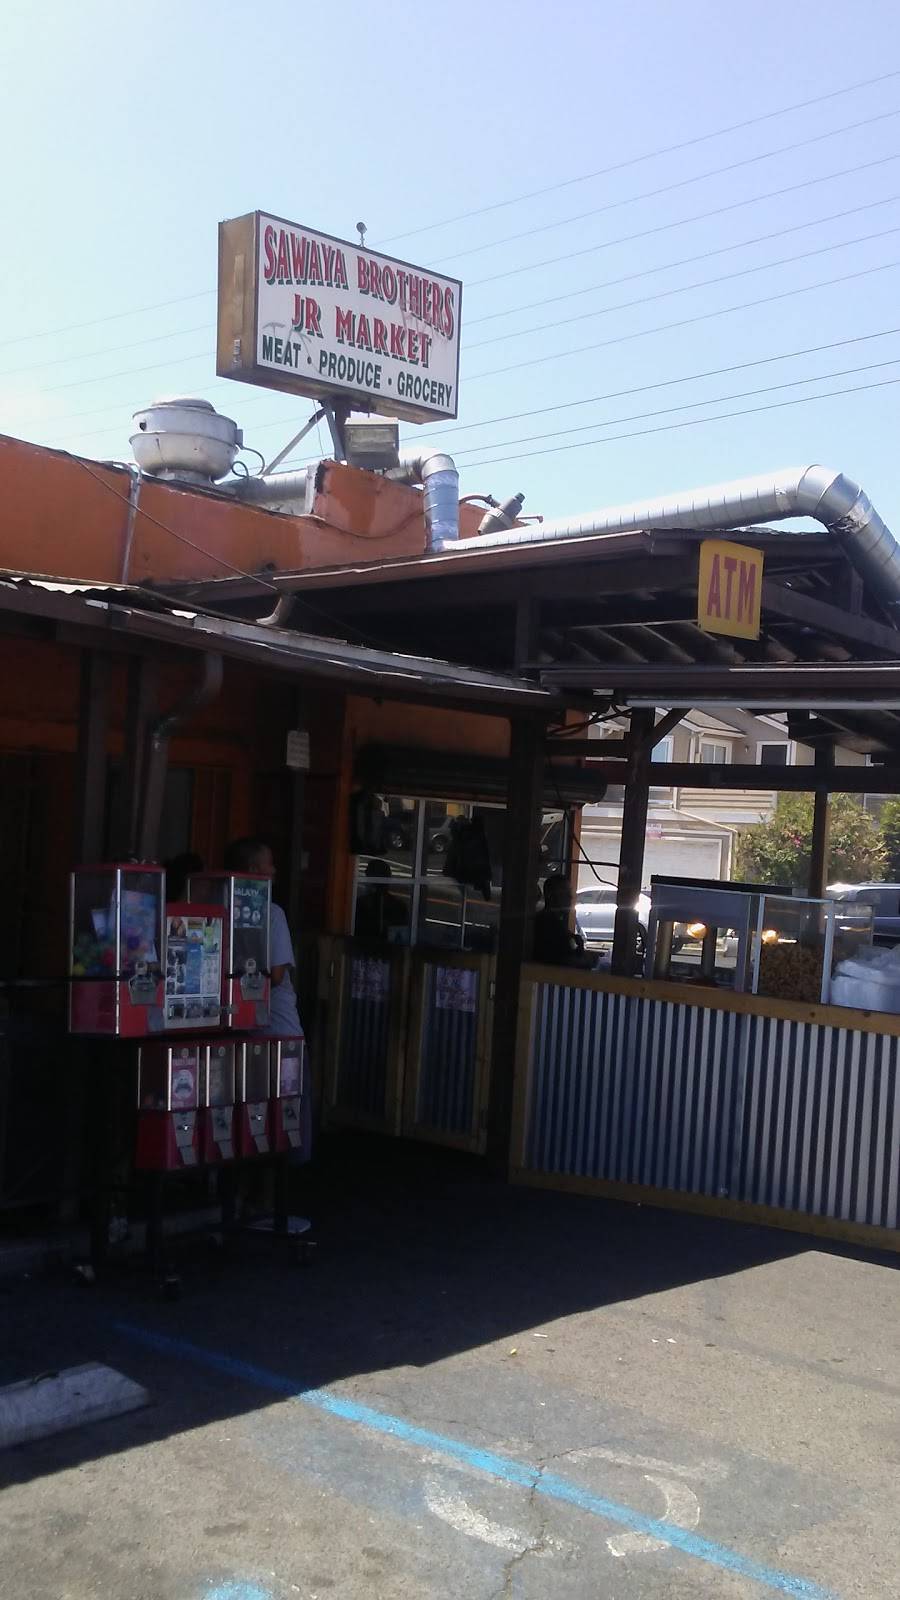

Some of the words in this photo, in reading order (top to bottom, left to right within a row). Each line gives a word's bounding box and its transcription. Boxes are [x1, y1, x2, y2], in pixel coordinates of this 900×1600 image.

[263, 224, 349, 290] SAWAYA
[356, 255, 455, 340] BROTHERS
[291, 293, 324, 339] JR
[335, 305, 432, 368] MARKET
[262, 334, 302, 369] MEAT
[319, 349, 382, 390] PRODUCE
[397, 371, 453, 408] GROCERY
[706, 553, 757, 625] ATM
